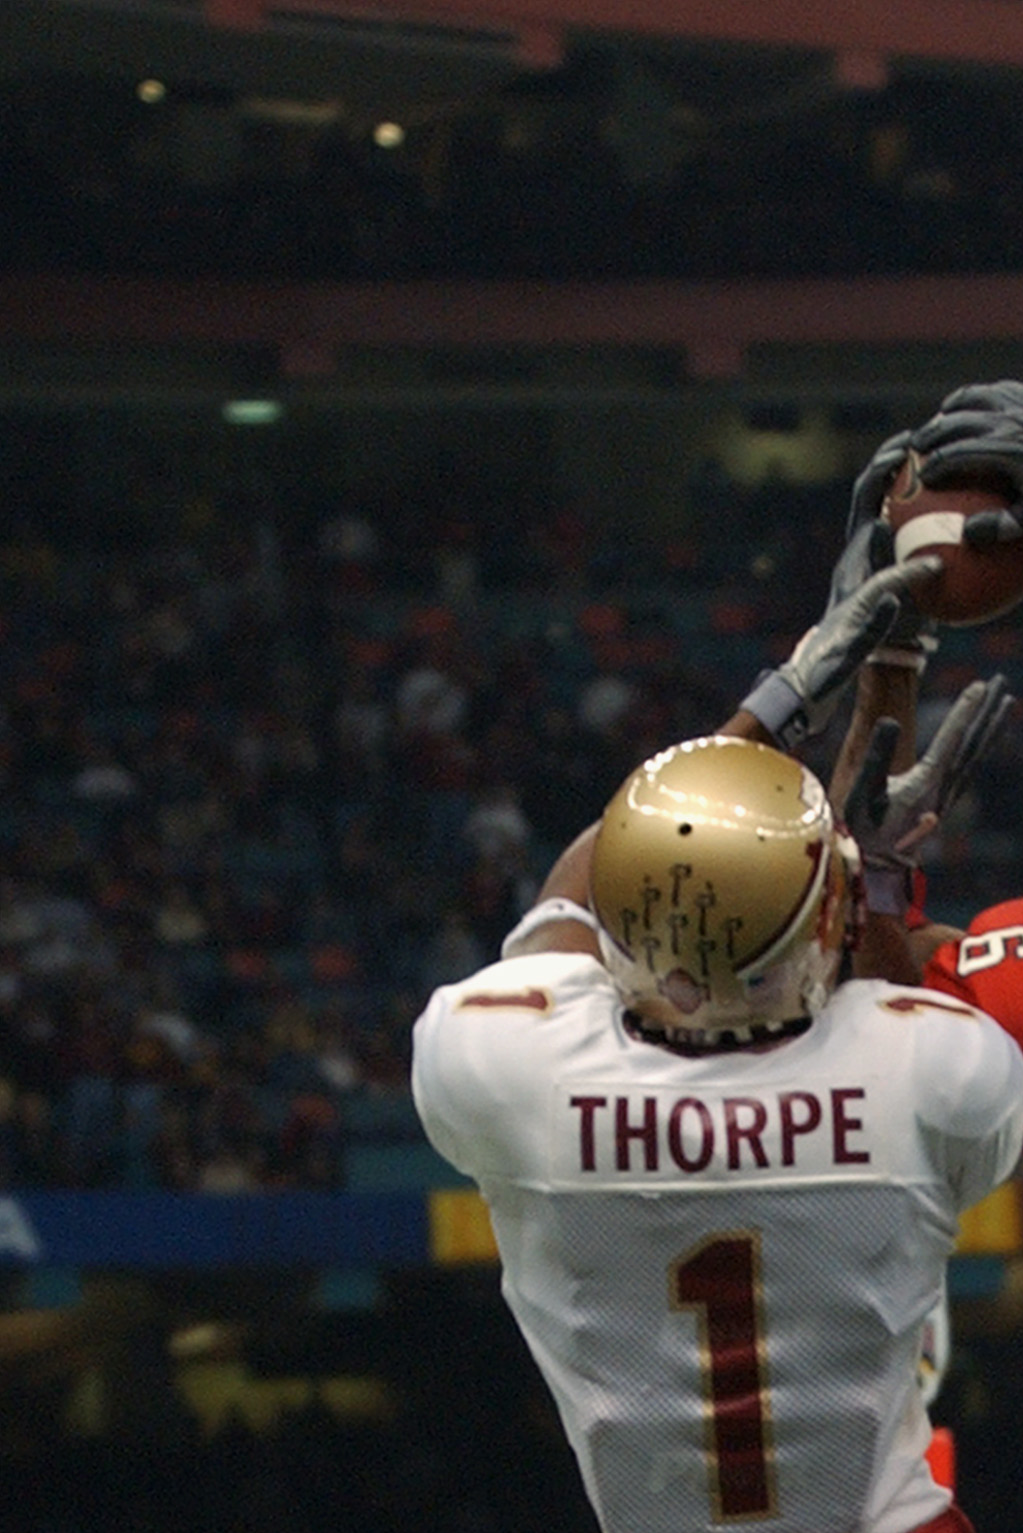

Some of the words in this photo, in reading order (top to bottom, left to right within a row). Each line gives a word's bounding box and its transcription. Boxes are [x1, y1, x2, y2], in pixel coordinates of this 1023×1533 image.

[453, 986, 556, 1020] 1
[569, 1087, 871, 1174] THORPE
[669, 1230, 779, 1523] 1
